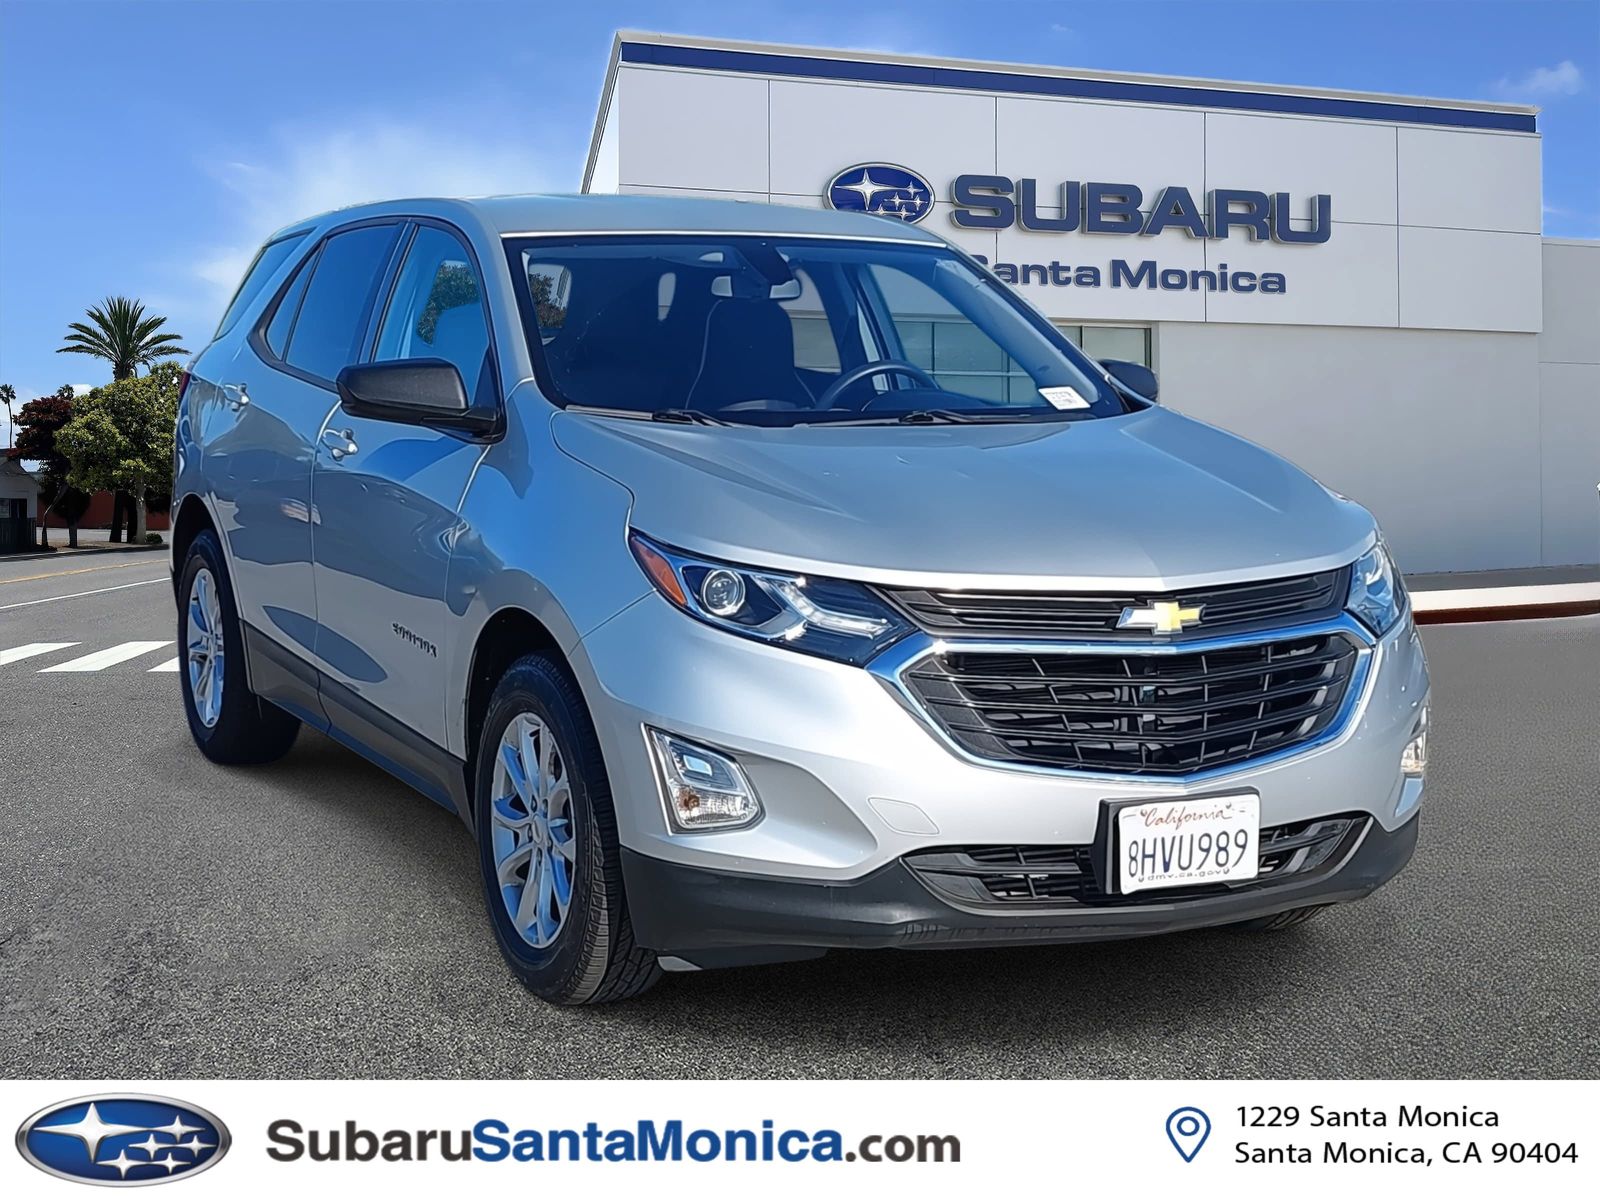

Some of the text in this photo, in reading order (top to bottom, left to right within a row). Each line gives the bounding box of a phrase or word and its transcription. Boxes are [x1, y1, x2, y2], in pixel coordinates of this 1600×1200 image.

[951, 174, 1331, 244] SUBARU
[1110, 259, 1287, 293] Monica
[1144, 805, 1232, 830] California
[1128, 829, 1248, 878] 8HVU989
[1147, 868, 1222, 881] dmv.ca.gov
